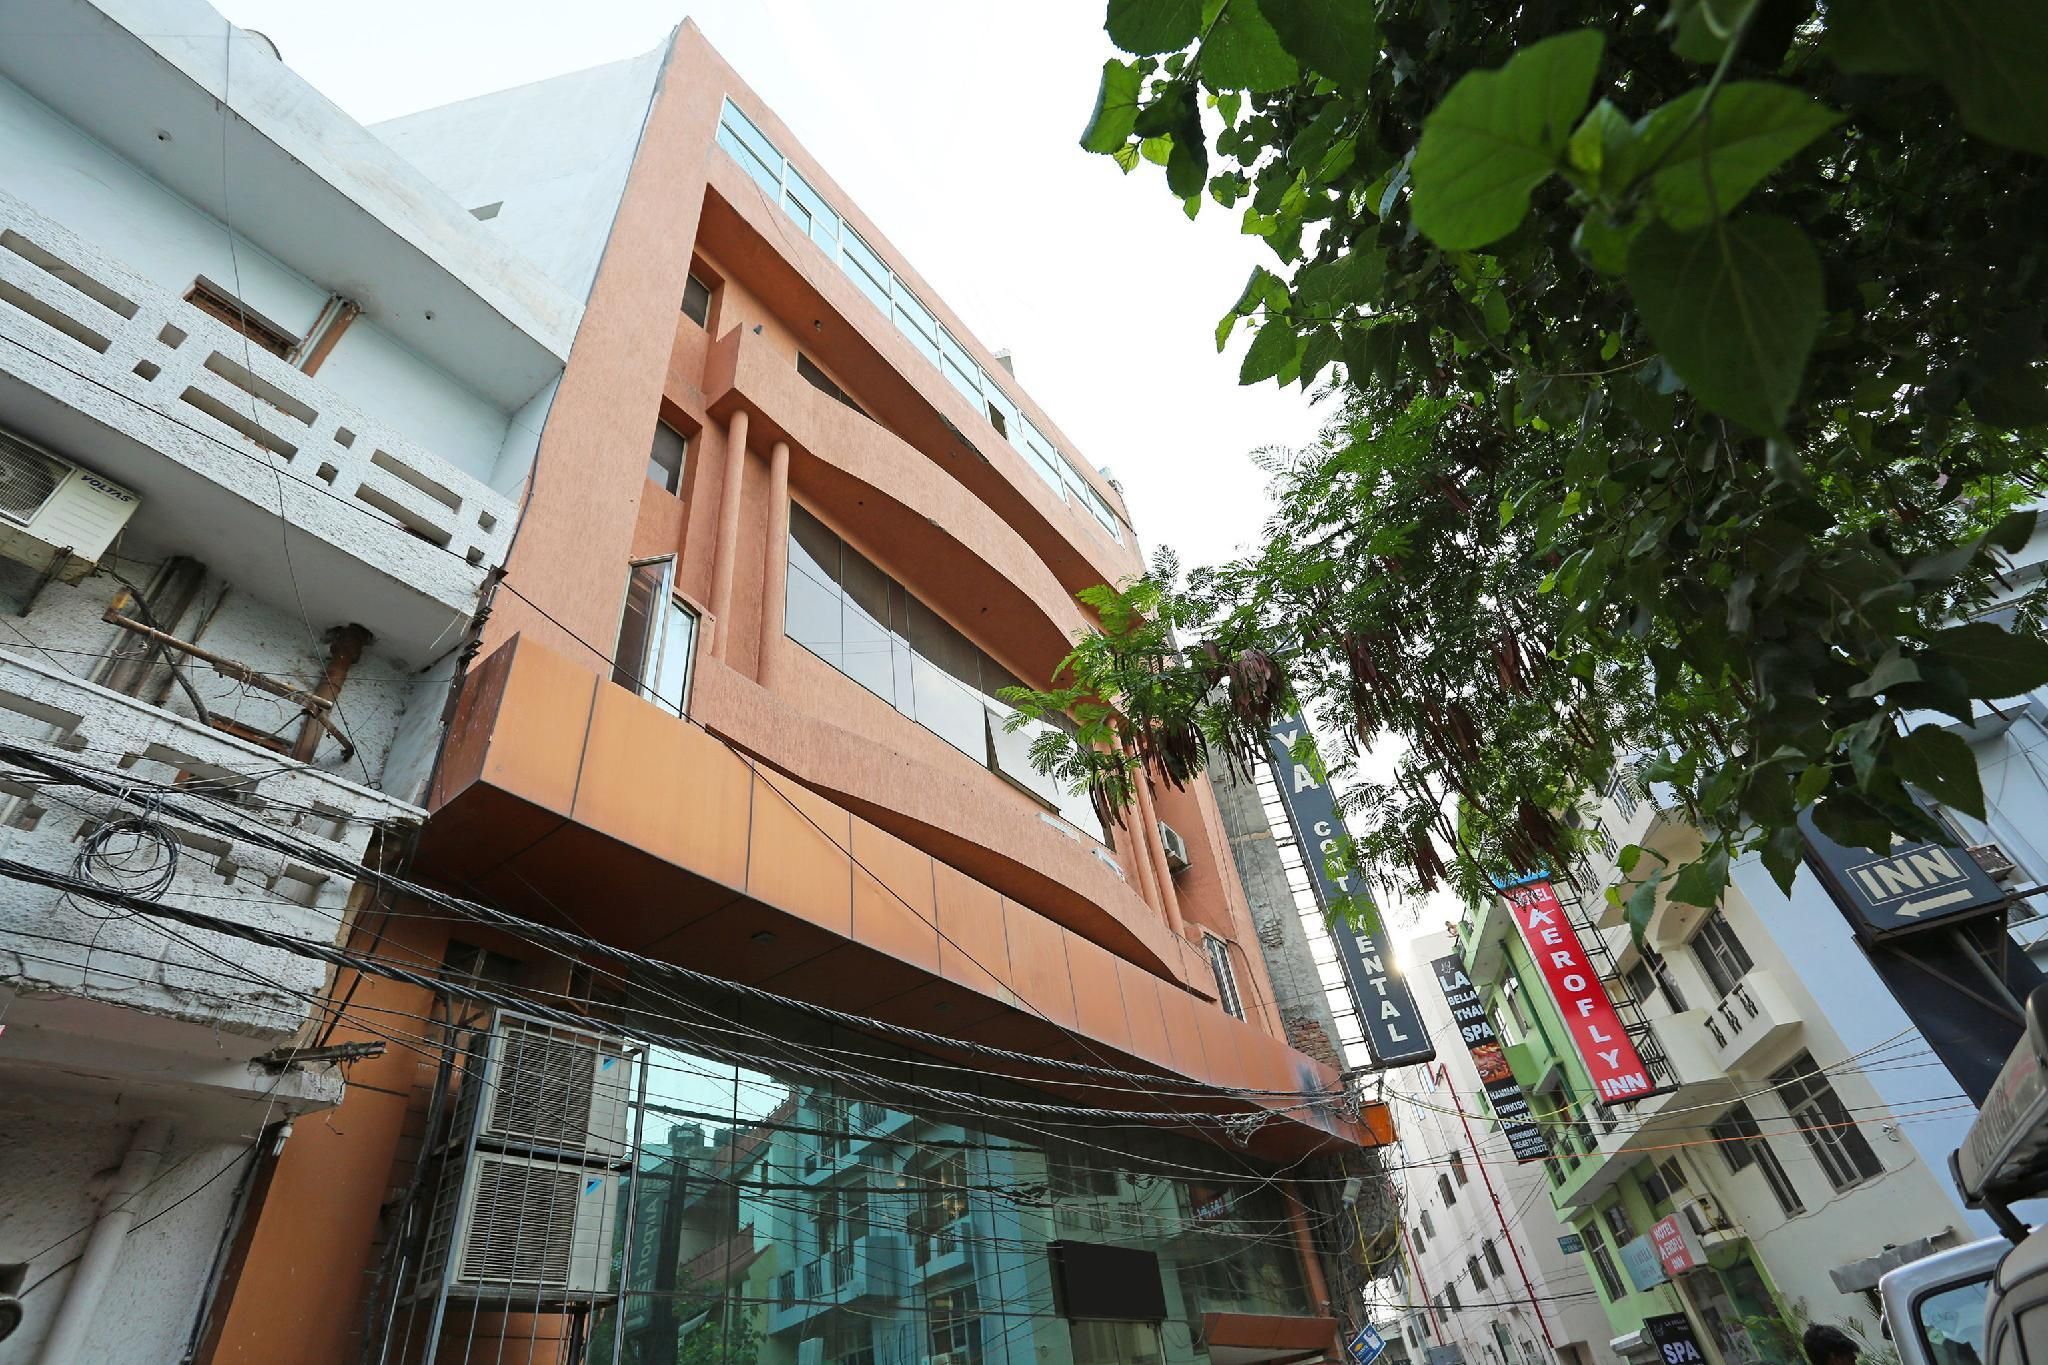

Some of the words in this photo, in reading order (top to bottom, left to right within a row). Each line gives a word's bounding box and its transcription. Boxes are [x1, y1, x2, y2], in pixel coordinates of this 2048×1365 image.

[81, 474, 132, 502] VOLTAS
[1857, 848, 1961, 900] INN
[1314, 821, 1408, 1042] CONTNENTAL
[1439, 970, 1470, 992] LA
[1529, 909, 1620, 1069] AEROFLY
[1447, 990, 1478, 1006] BELLA
[1454, 1004, 1485, 1022] THAI
[1462, 1022, 1494, 1044] SPA
[1600, 1072, 1647, 1097] INN
[1496, 1101, 1528, 1116] TURKISH
[1503, 1111, 1536, 1130] BATH
[1653, 1221, 1675, 1241] HOTEL
[1659, 1235, 1686, 1260] AEROFLY
[1671, 1255, 1686, 1270] INN
[1663, 1340, 1701, 1364] SPA
